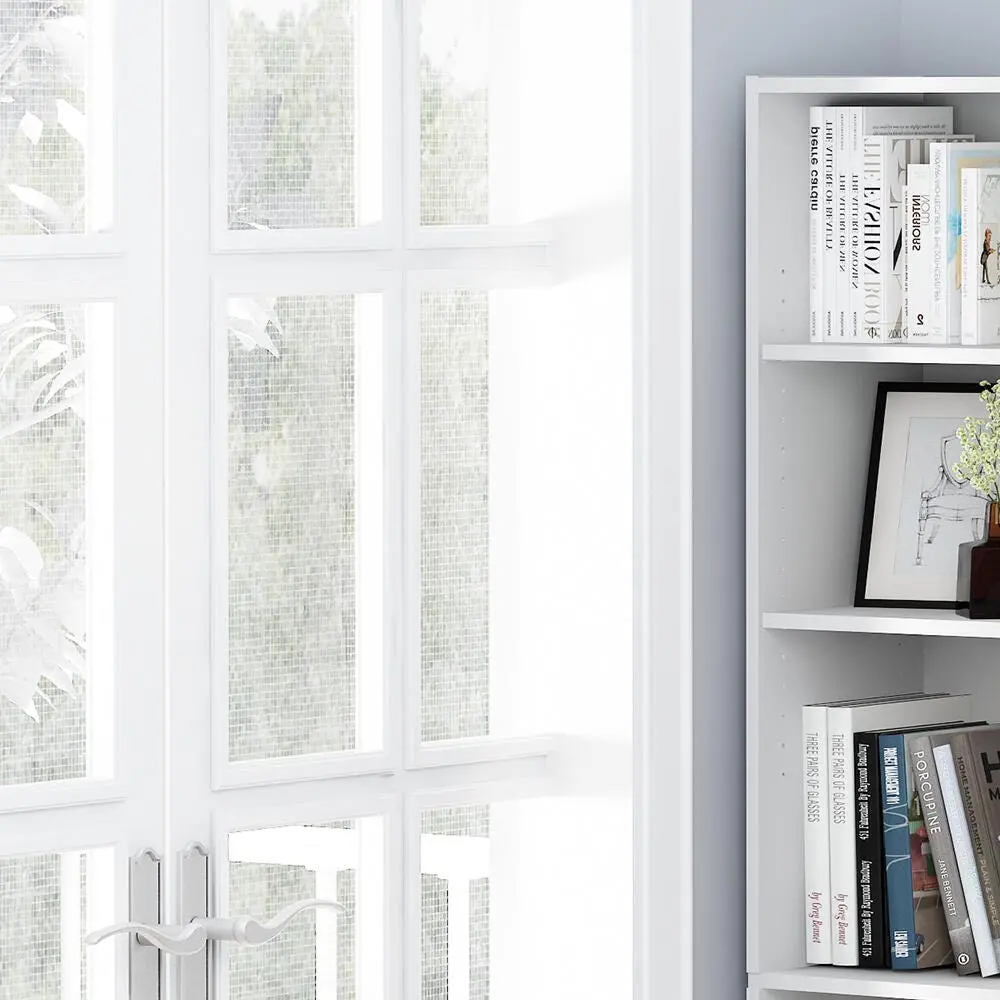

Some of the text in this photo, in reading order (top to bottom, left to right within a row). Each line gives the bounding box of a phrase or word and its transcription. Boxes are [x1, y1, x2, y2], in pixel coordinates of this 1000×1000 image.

[806, 732, 820, 823] THREE PAIRS OF GLASSES
[832, 734, 846, 824] THREE PAIRS OF GLASSES
[913, 750, 941, 835] PORCUPINE
[956, 756, 970, 786] HOME
[937, 859, 957, 917] JANE BENNETT
